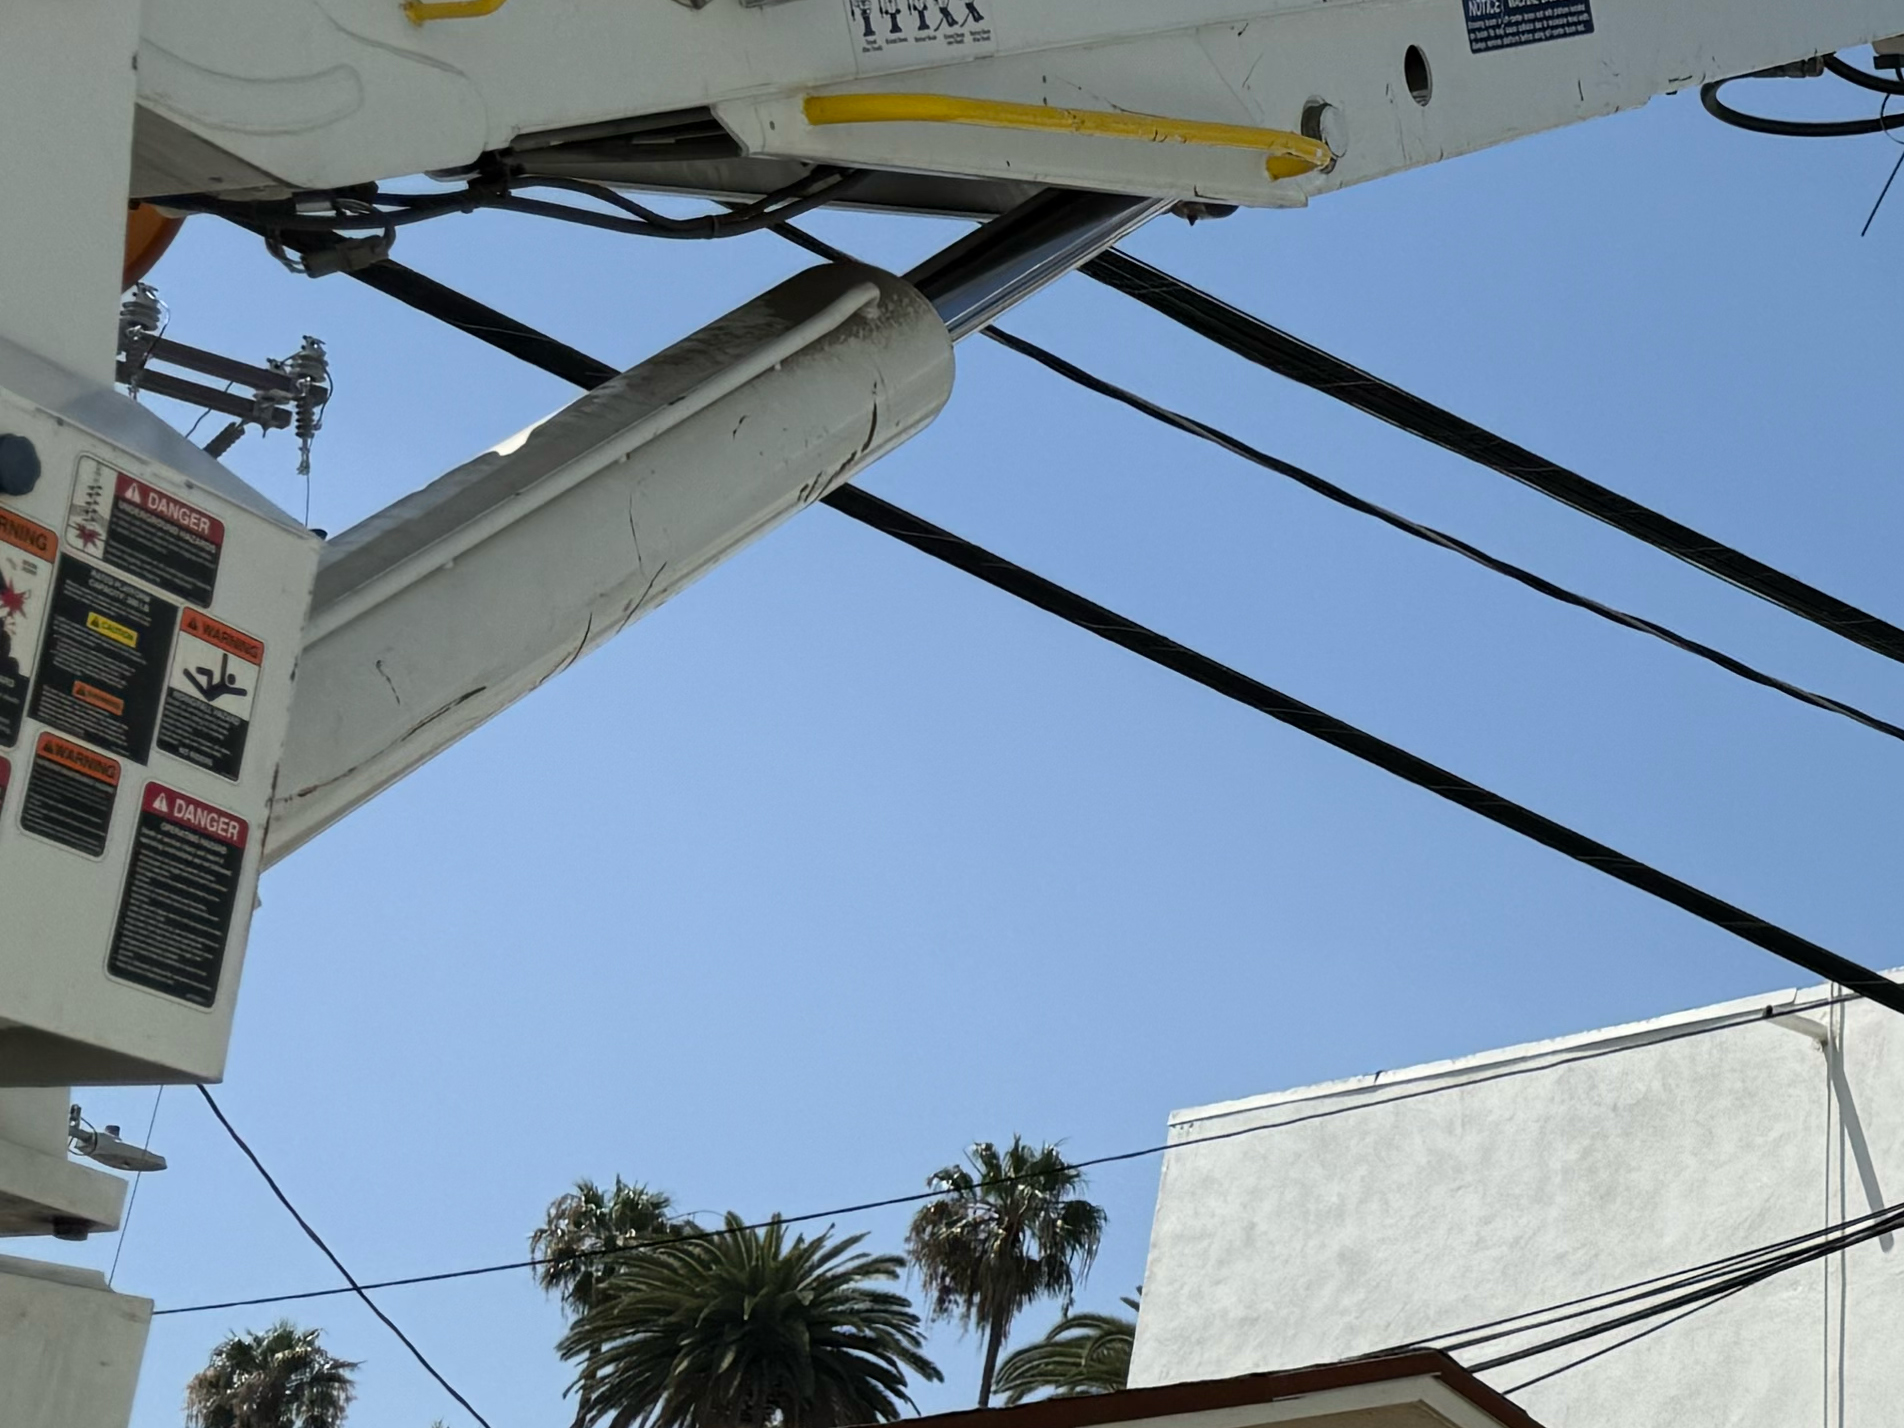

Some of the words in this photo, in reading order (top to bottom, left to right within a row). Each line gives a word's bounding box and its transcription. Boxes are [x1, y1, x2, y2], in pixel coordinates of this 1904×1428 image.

[148, 492, 211, 534] DANGER
[203, 623, 259, 659] WARNING
[52, 744, 117, 778] WARNING
[173, 799, 240, 841] DANGER
